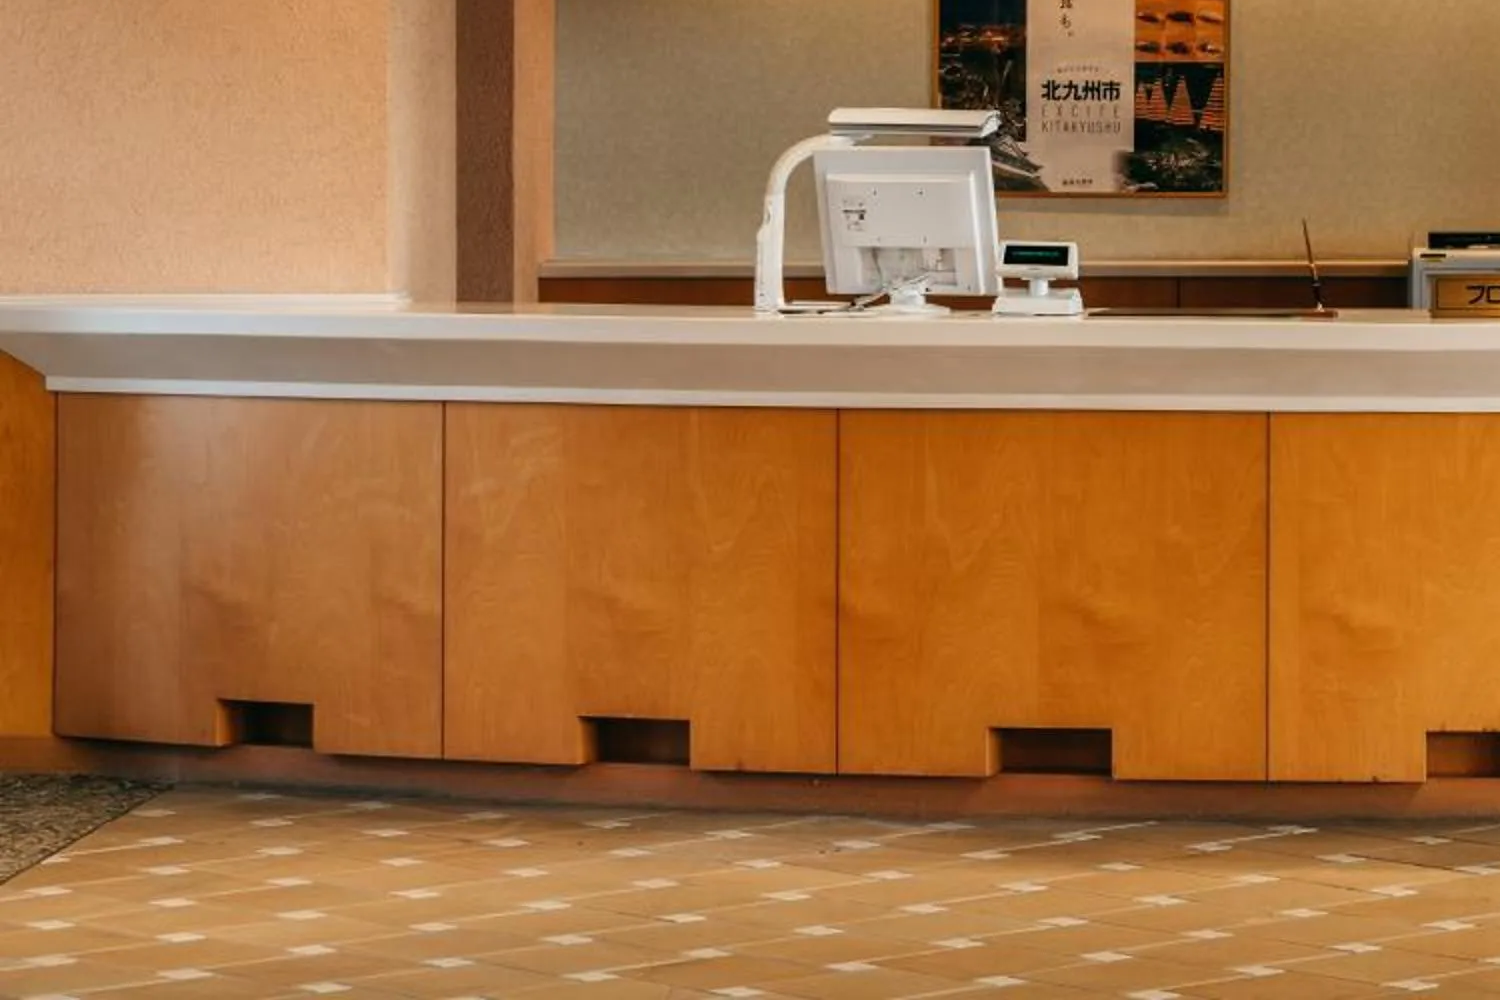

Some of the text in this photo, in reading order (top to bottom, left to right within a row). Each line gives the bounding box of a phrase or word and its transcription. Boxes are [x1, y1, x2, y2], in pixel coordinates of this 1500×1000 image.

[1041, 79, 1121, 101] 北九州市
[1041, 120, 1121, 133] KITAKYUSHU
